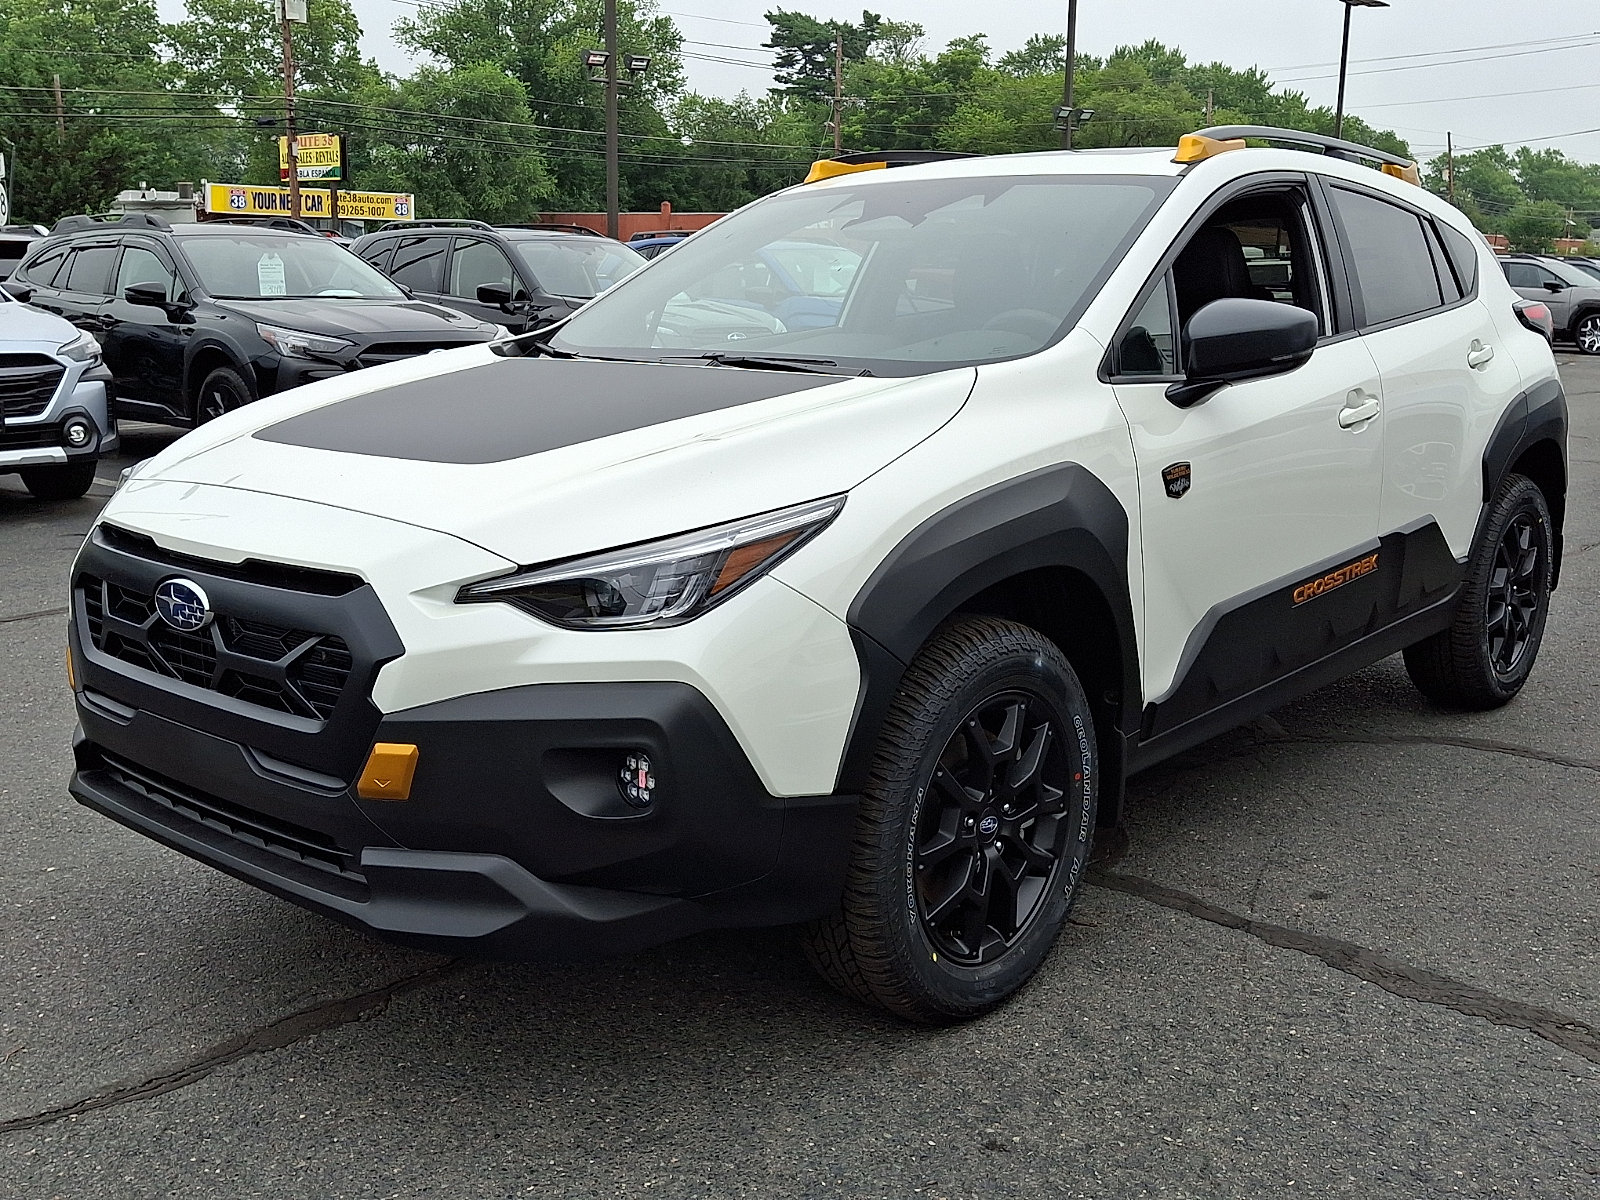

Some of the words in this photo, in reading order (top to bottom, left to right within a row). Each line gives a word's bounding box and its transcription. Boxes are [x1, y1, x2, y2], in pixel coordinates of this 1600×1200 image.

[296, 135, 320, 147] UTE
[322, 135, 333, 146] 38
[315, 150, 339, 163] RENTALS
[297, 169, 311, 178] BLA
[231, 195, 246, 208] 38
[251, 191, 278, 211] YOUR
[280, 193, 304, 212] NET
[304, 194, 323, 213] CAR
[326, 193, 392, 205] rte38auto.com
[327, 203, 386, 217] (09)265-1007
[395, 203, 408, 215] 38
[1293, 553, 1379, 604] CROSSTREK
[1073, 714, 1092, 843] GEOLANDAR
[906, 787, 925, 924] YOKOHAMA
